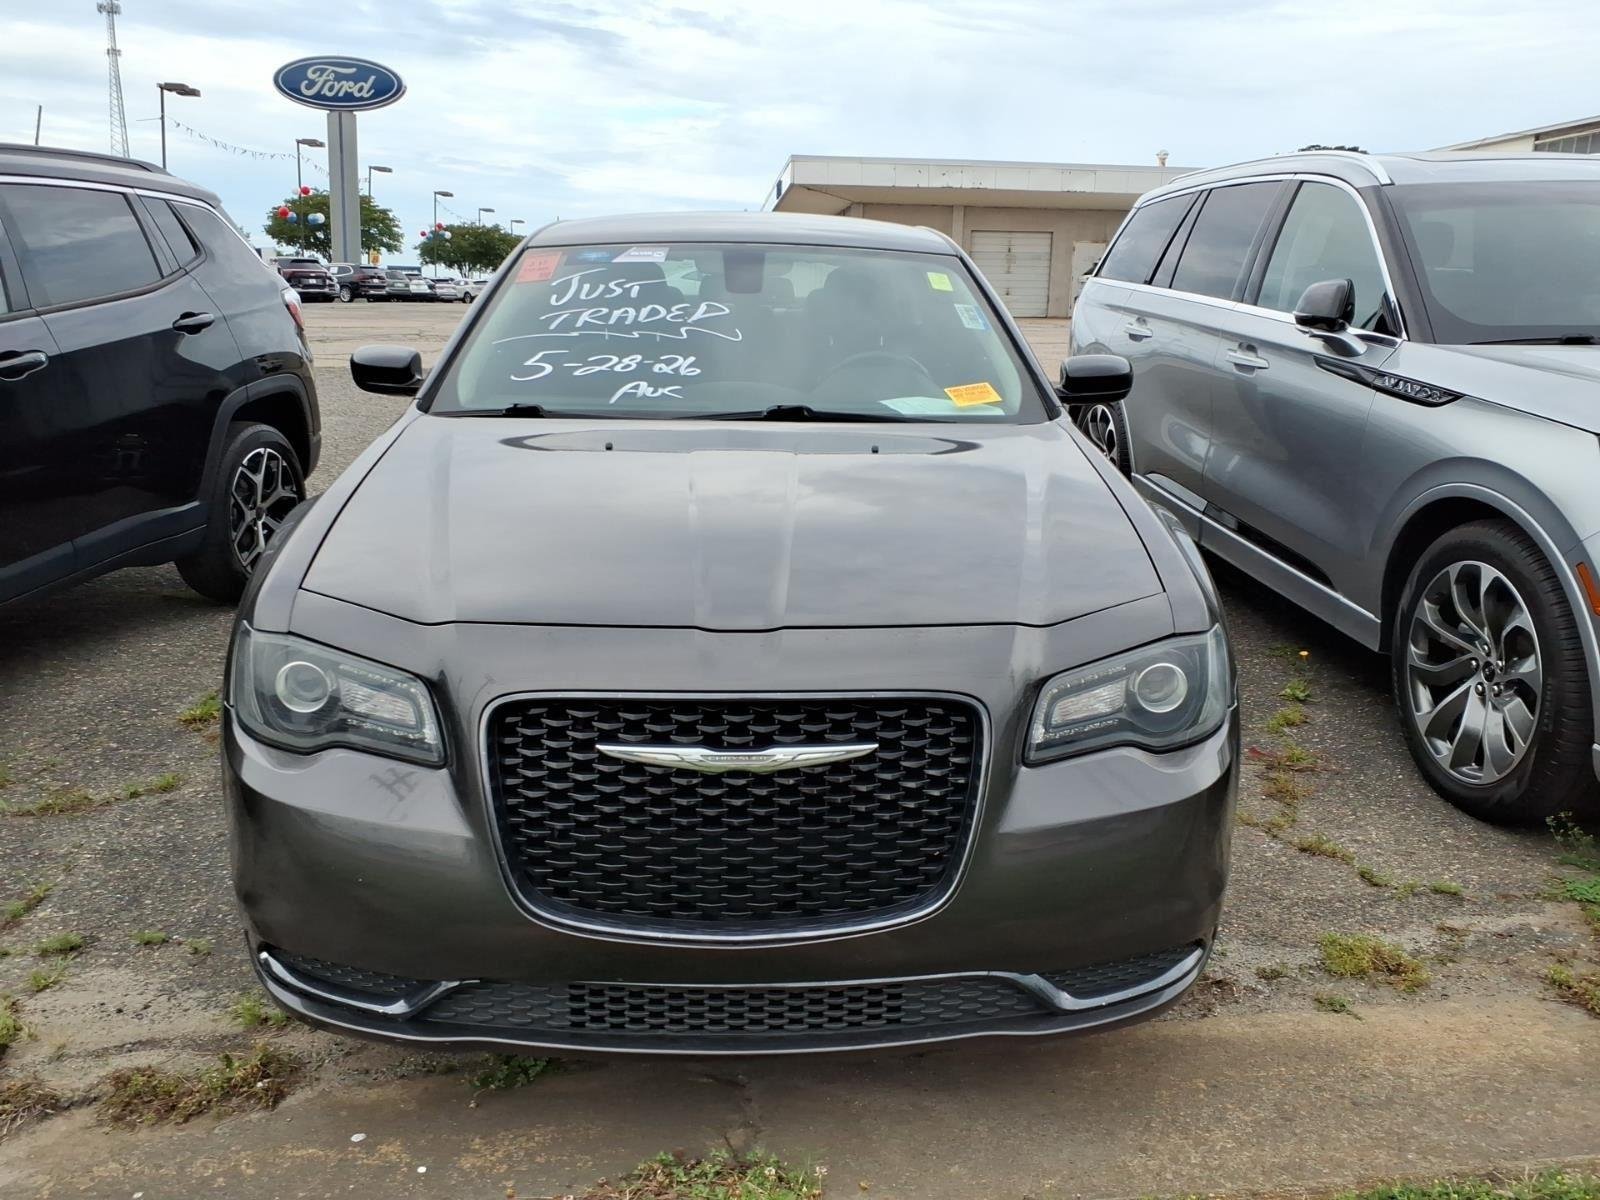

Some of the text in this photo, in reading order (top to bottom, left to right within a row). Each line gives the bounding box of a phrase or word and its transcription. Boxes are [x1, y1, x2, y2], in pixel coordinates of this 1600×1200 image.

[300, 64, 376, 97] Ford
[550, 267, 668, 306] JUST
[539, 301, 730, 330] TRADED
[510, 350, 702, 381] 5-28-26
